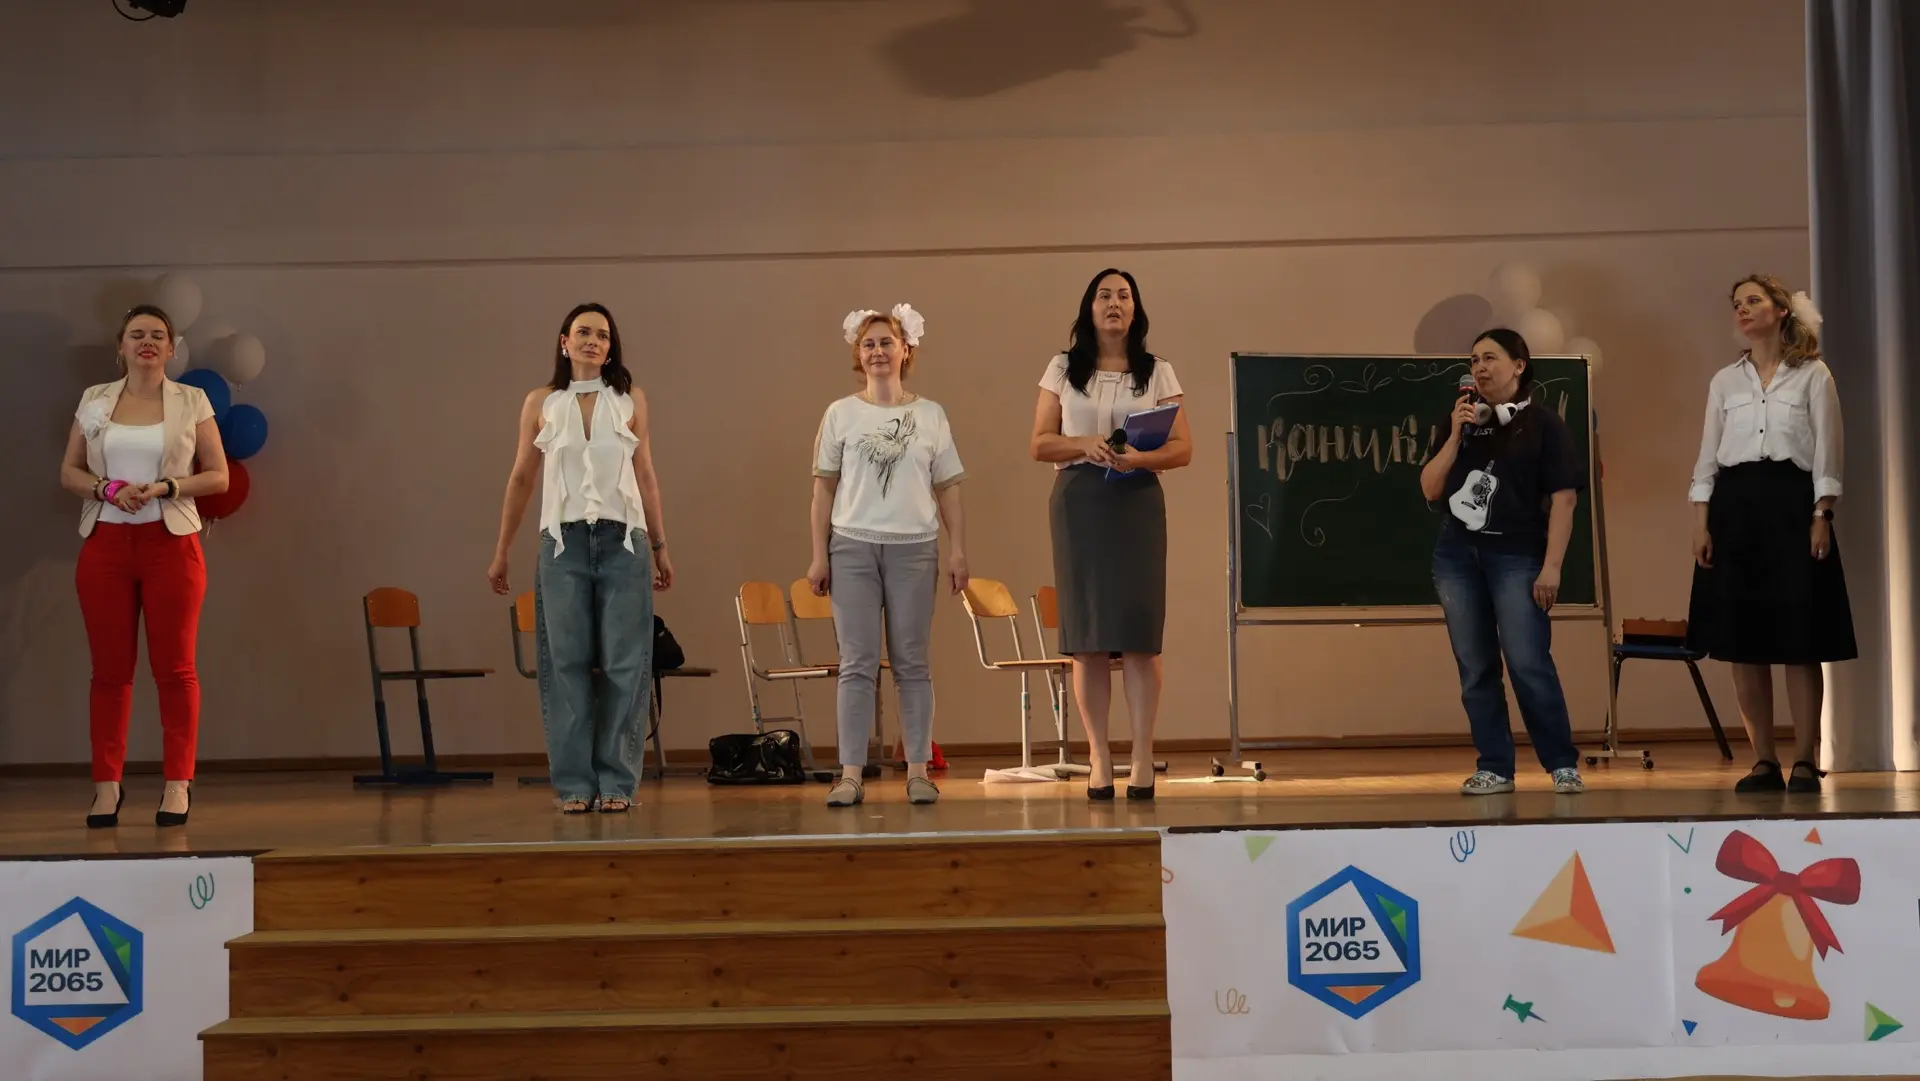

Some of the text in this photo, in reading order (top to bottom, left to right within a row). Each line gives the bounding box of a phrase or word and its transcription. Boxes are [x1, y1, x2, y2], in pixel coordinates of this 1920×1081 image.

[1305, 917, 1366, 938] МИР
[30, 948, 91, 969] МИР
[1305, 940, 1380, 962] 2065
[29, 972, 104, 993] 2065
